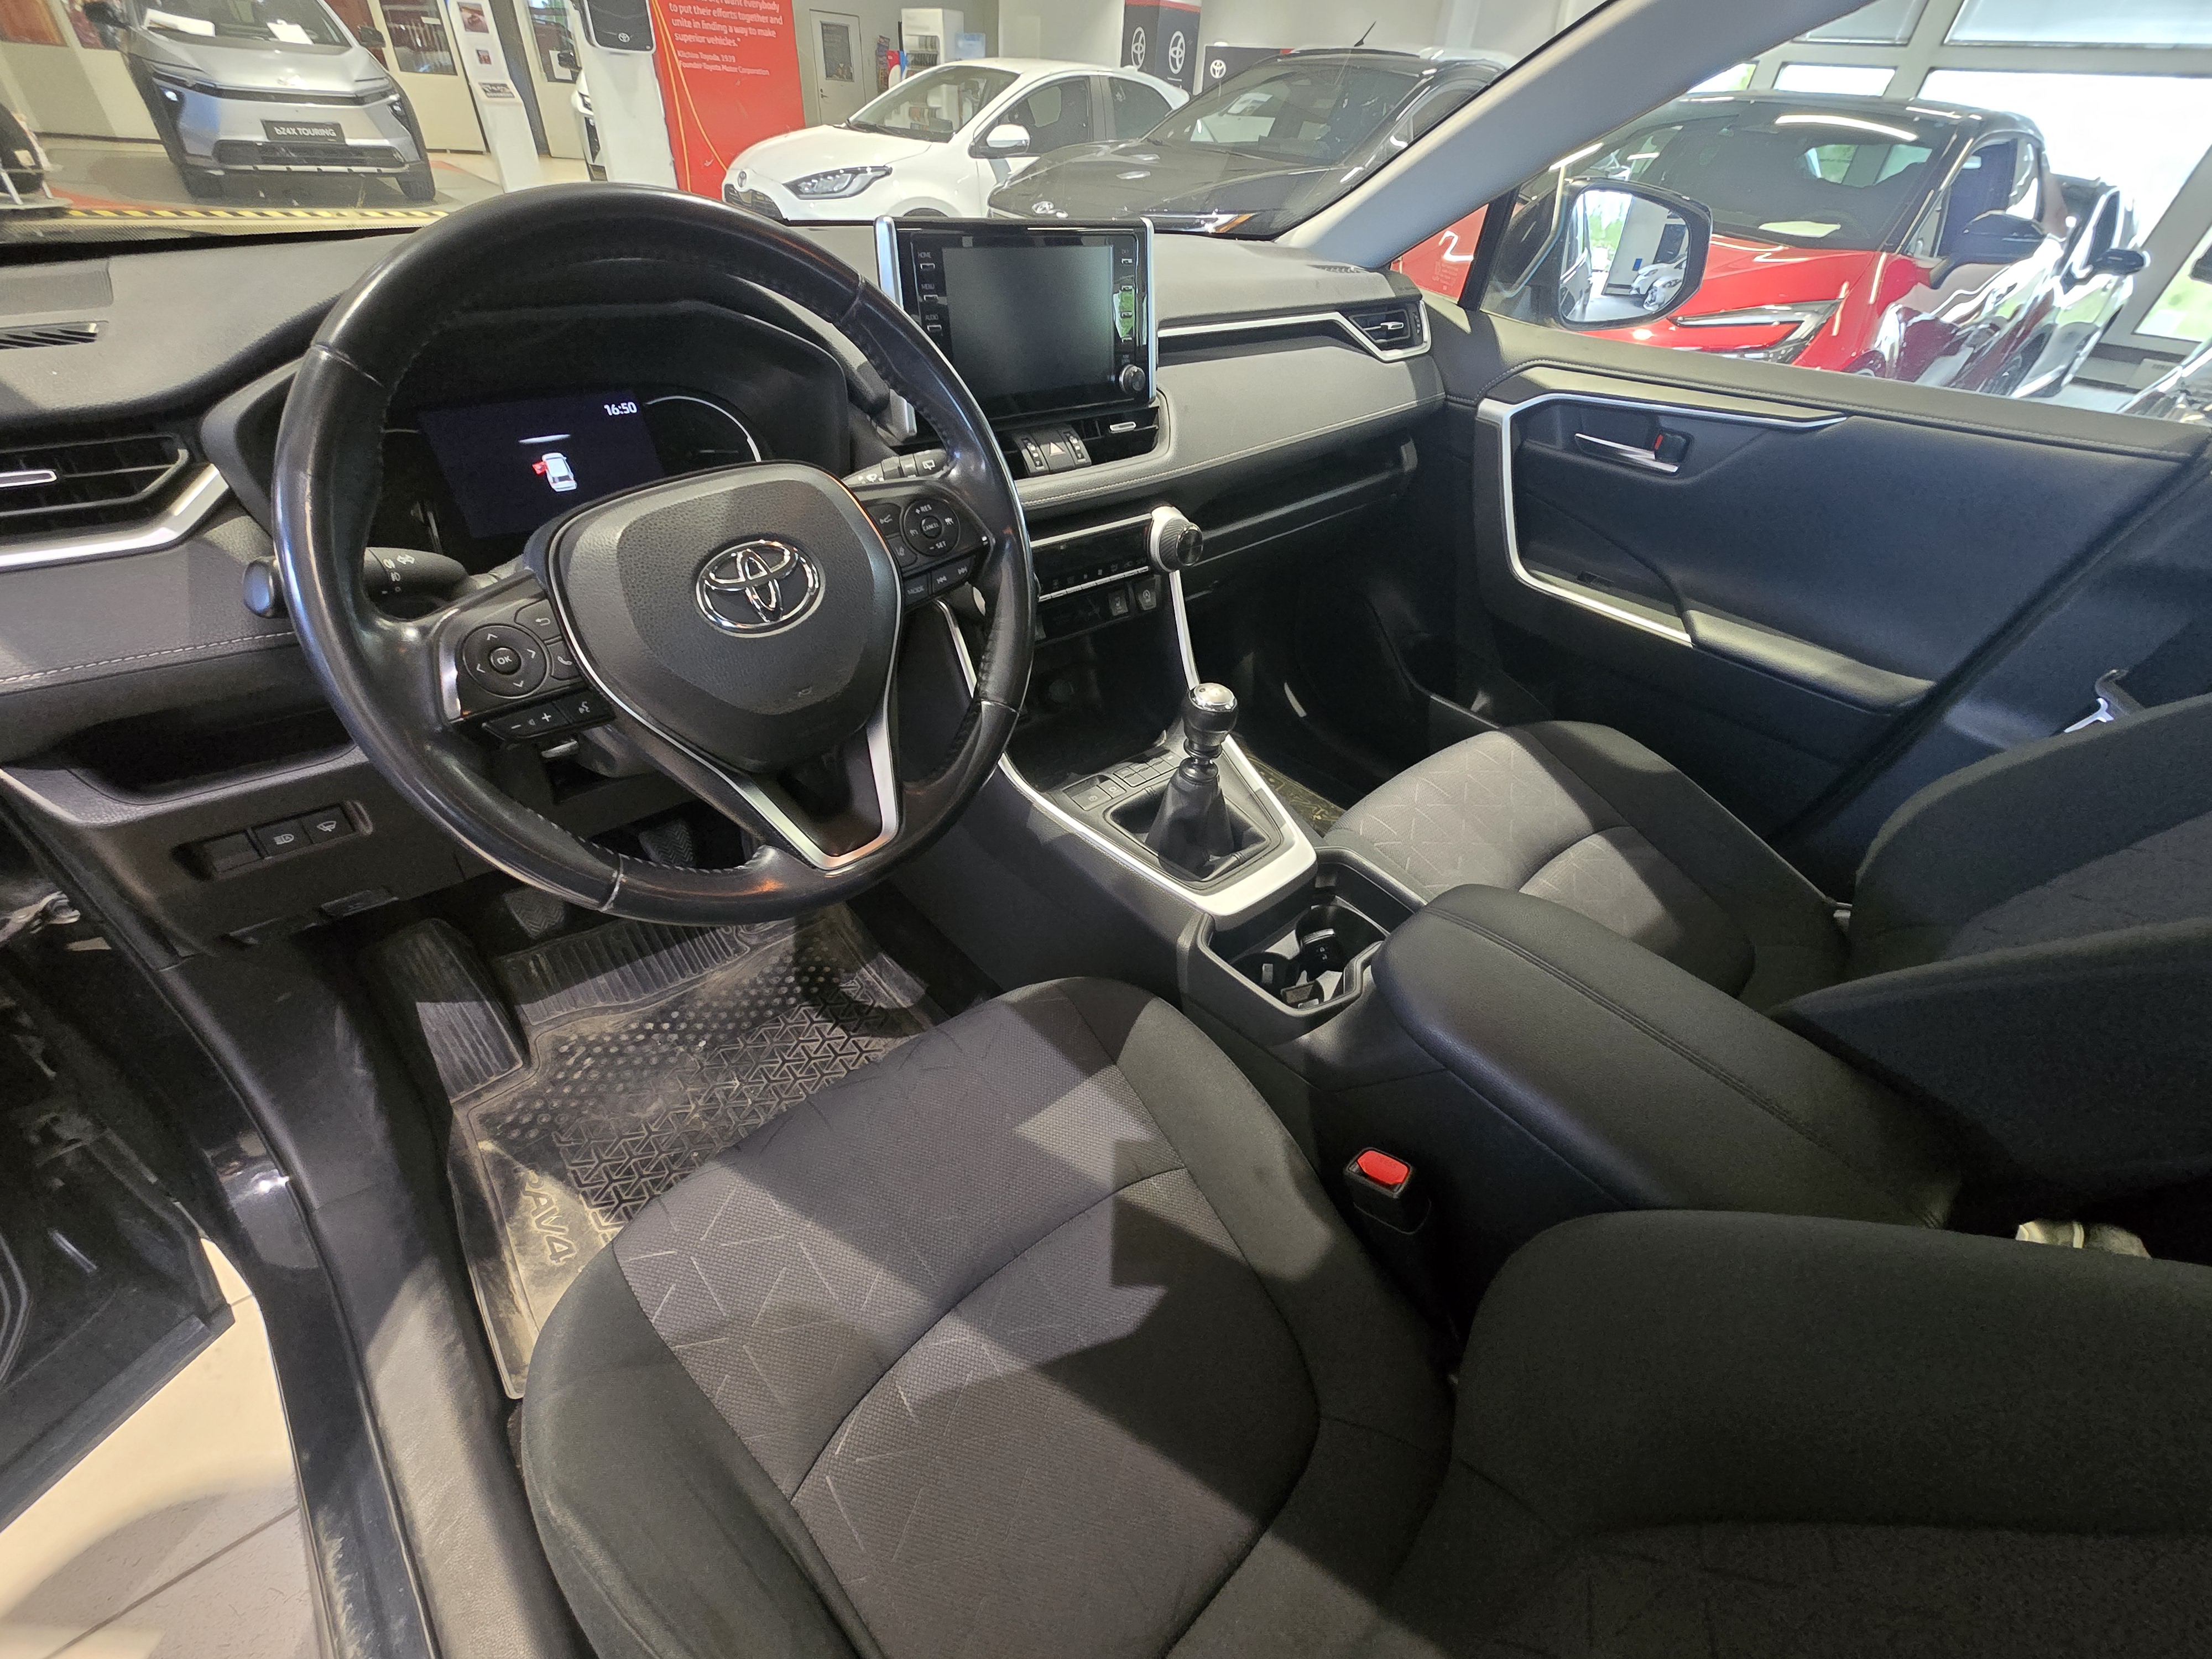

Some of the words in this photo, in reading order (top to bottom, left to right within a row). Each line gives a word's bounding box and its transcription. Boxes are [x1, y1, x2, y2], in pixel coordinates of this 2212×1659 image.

[744, 0, 780, 13] everybody
[669, 2, 678, 12] to
[679, 6, 692, 15] put
[693, 6, 711, 16] their
[712, 8, 738, 19] efforts
[738, 12, 769, 23] together
[769, 15, 783, 25] and
[671, 17, 692, 28] unite
[692, 19, 701, 29] in
[701, 20, 728, 34] finding
[734, 27, 748, 36] way
[748, 27, 757, 35] to
[757, 28, 776, 38] make
[674, 32, 706, 44] superior
[297, 127, 336, 137] TOURING
[604, 401, 637, 416] 16:50
[922, 523, 939, 531] CANCEL
[907, 585, 925, 595] MODE
[497, 655, 512, 665] OK
